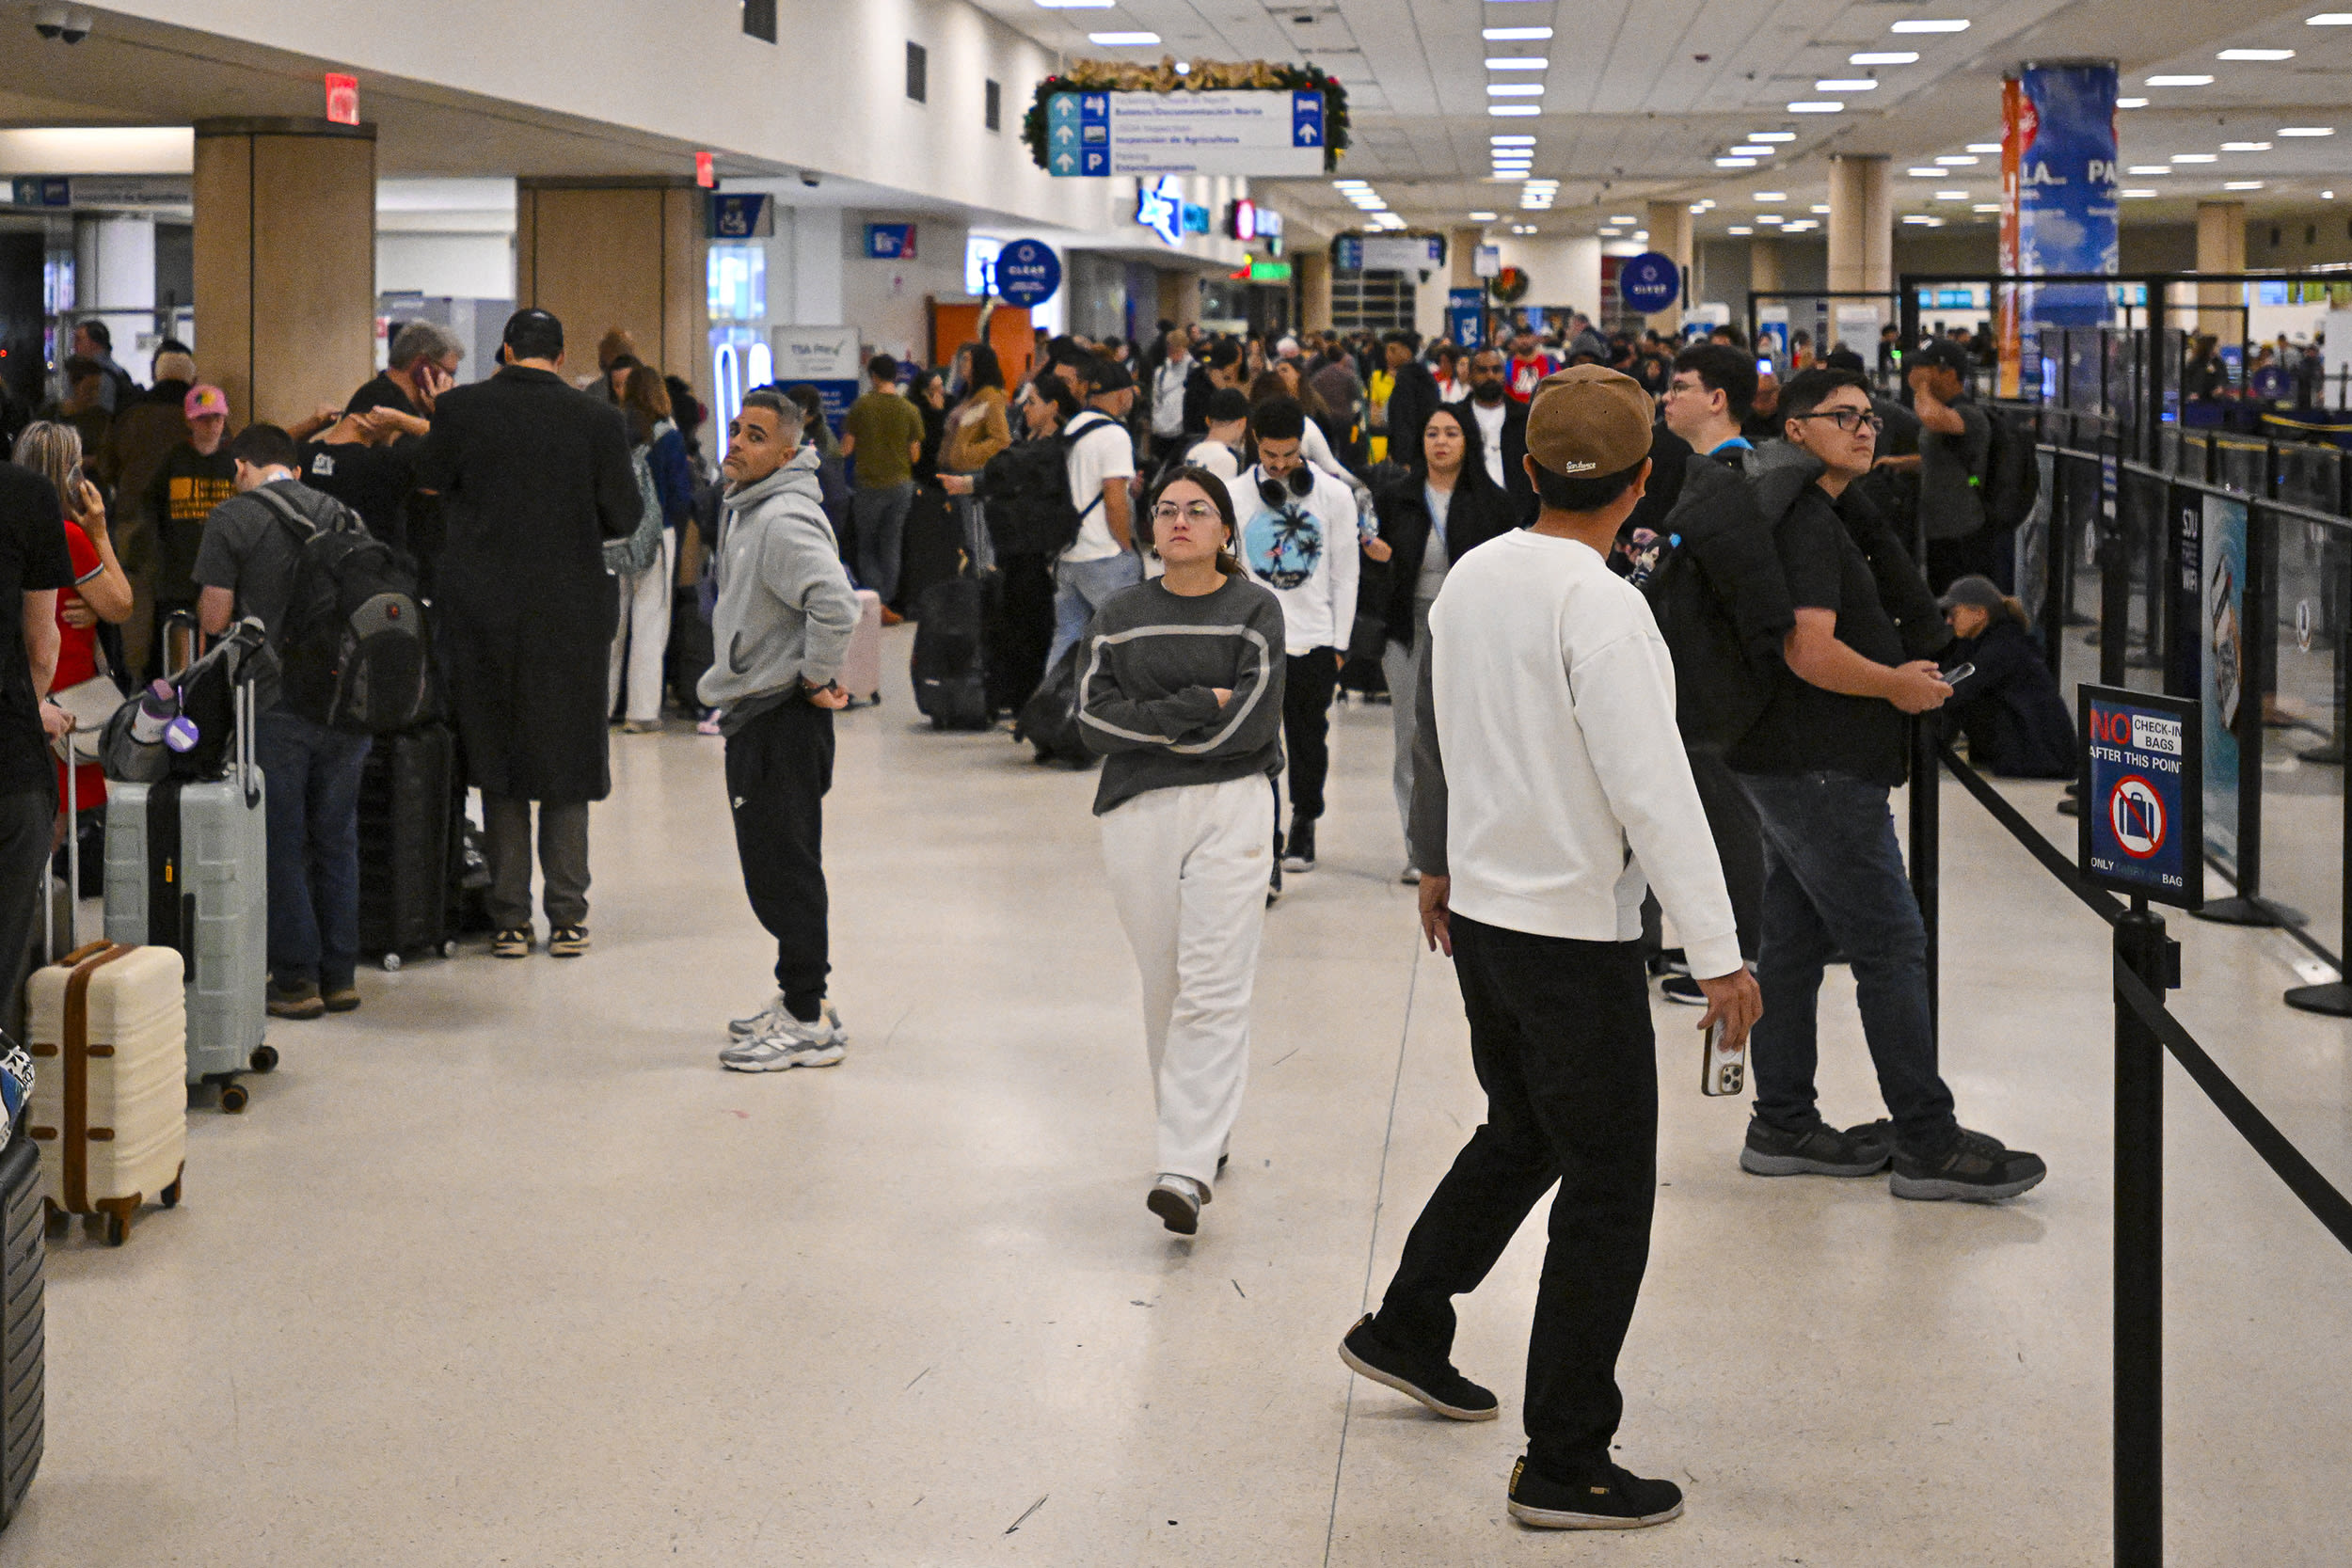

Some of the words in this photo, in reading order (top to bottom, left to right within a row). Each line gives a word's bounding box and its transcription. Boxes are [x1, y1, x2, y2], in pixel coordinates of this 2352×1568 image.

[2090, 709, 2132, 745] NO
[2134, 719, 2182, 737] CHECK-IN
[2089, 745, 2122, 763] AFTER
[2124, 752, 2150, 768] THIS
[2145, 736, 2174, 752] BAGS
[2090, 857, 2114, 871] ONLY
[2162, 873, 2183, 887] BAG
